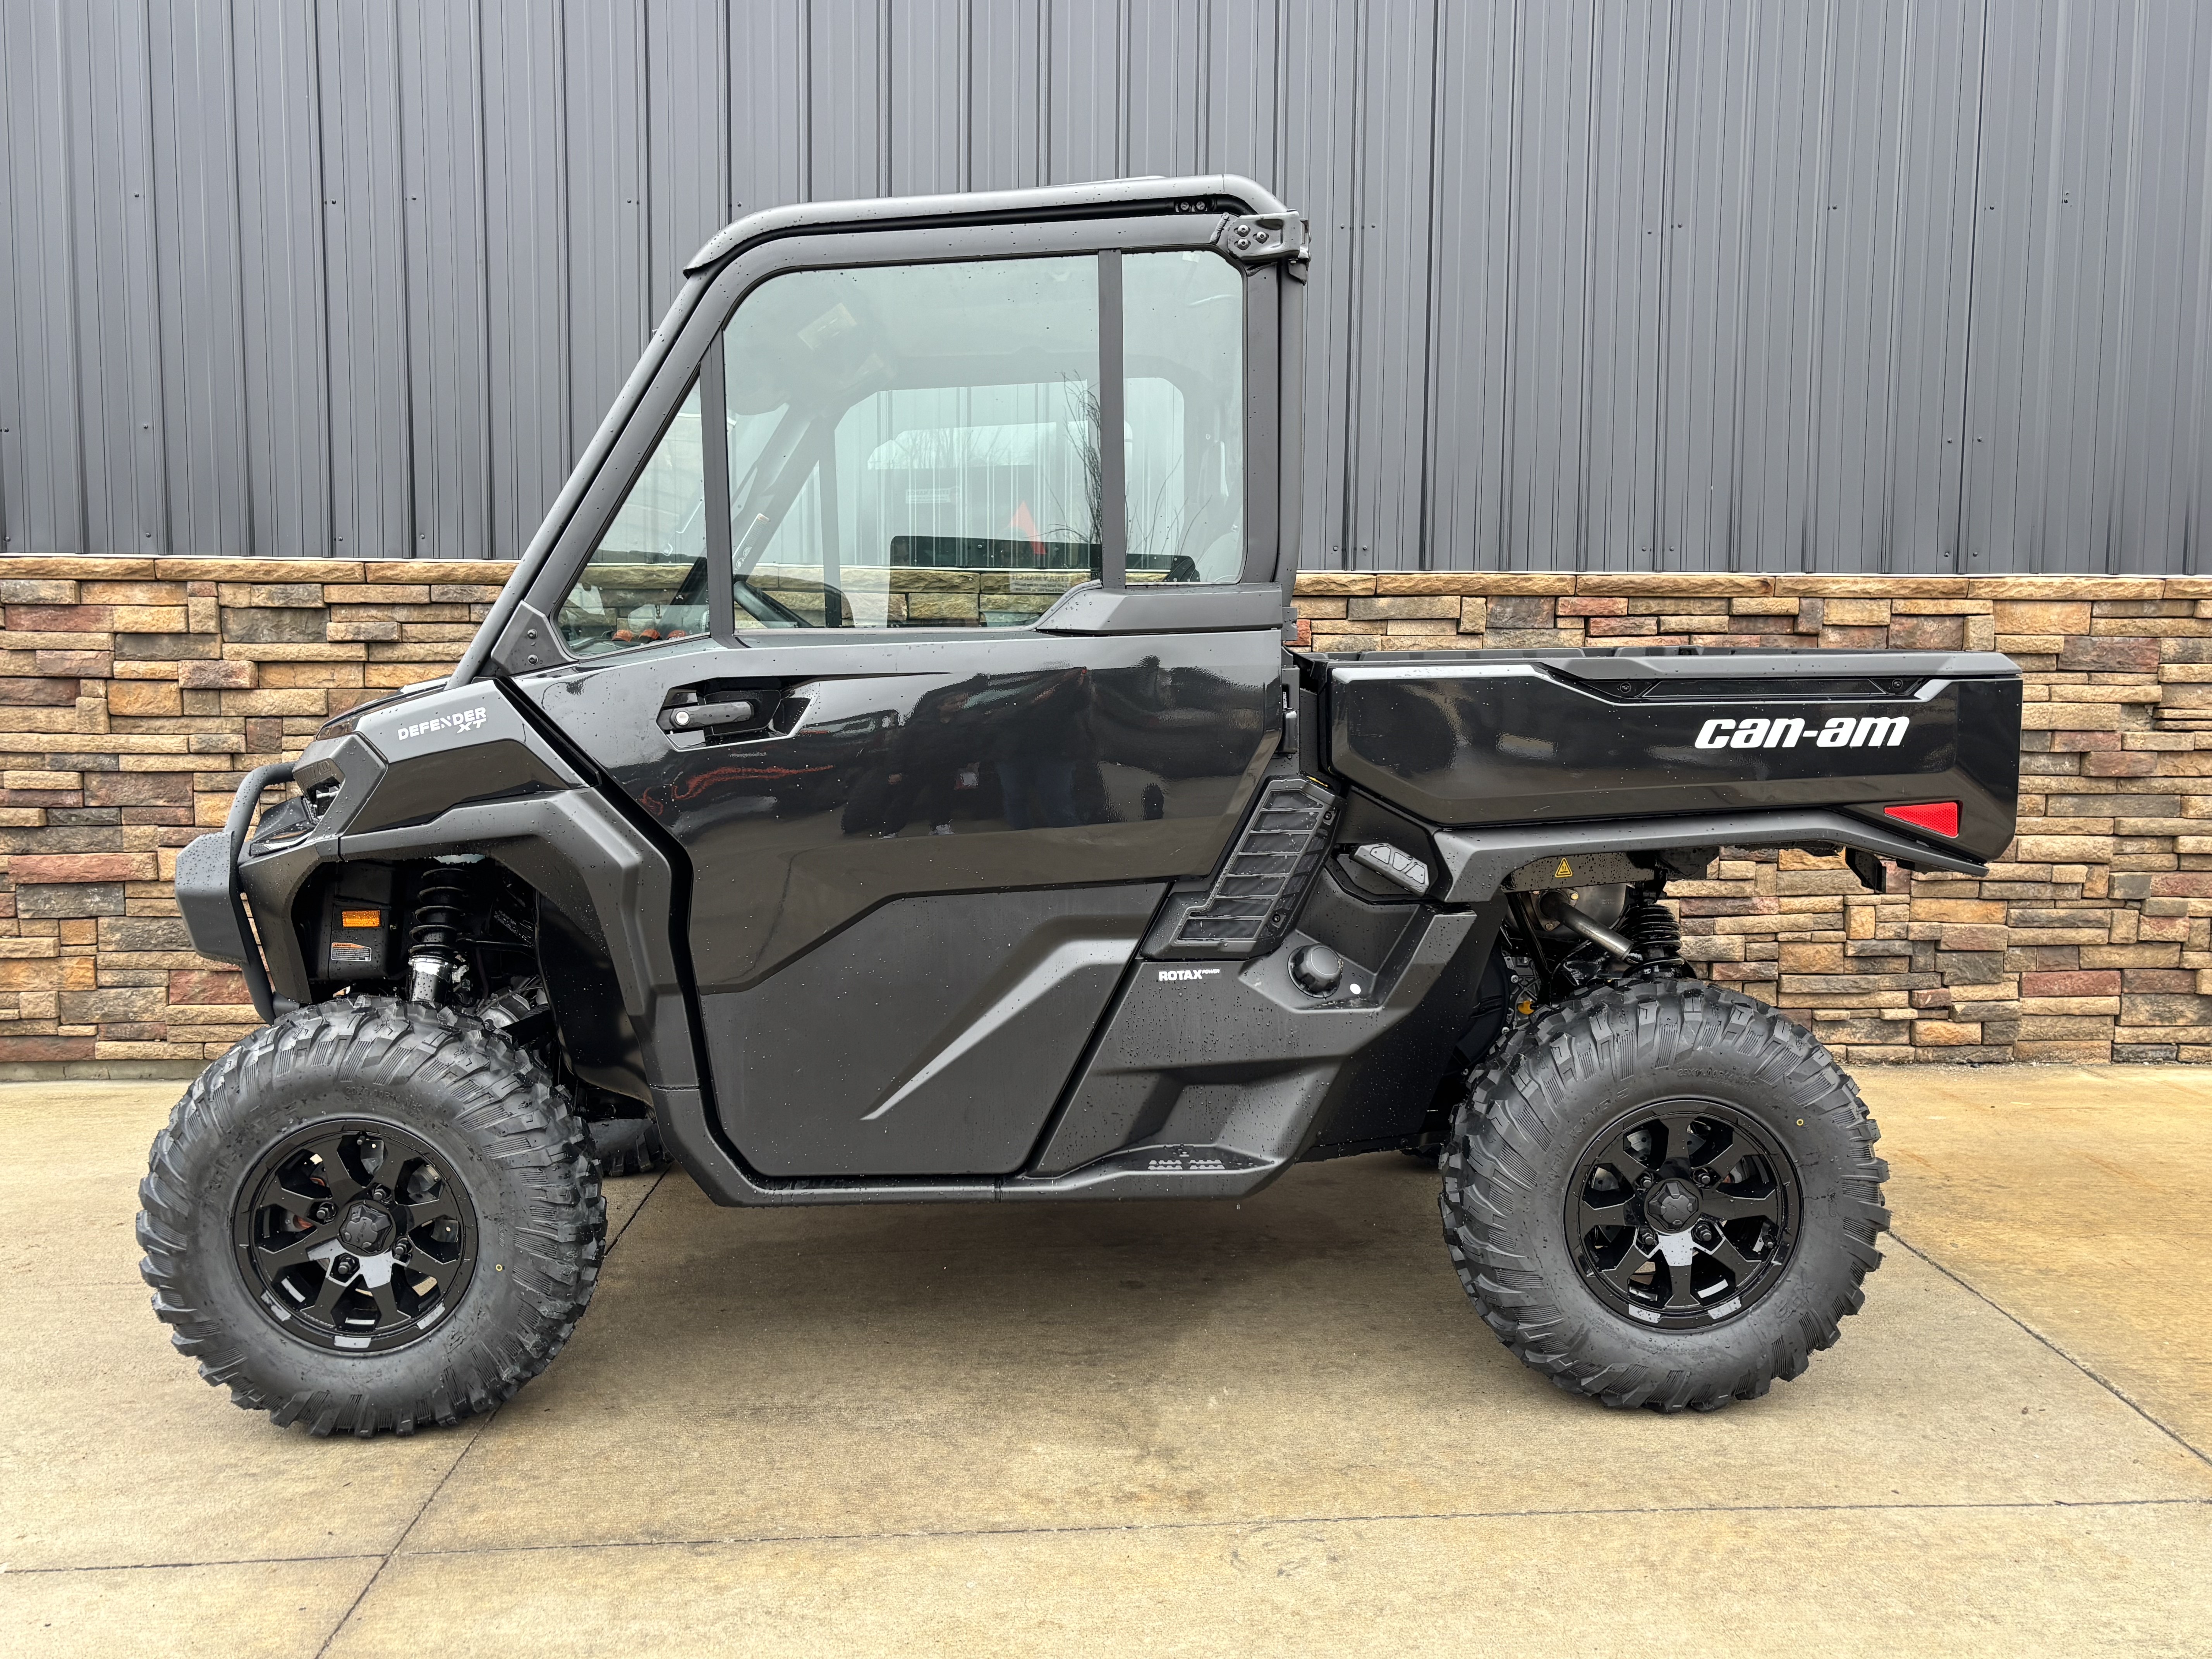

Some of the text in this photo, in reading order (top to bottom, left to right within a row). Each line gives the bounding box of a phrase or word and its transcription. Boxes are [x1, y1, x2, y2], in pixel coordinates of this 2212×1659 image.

[398, 707, 486, 740] DEFENDER
[457, 718, 486, 733] XT
[1695, 716, 1910, 749] can-am
[1159, 969, 1202, 981] ROTAX
